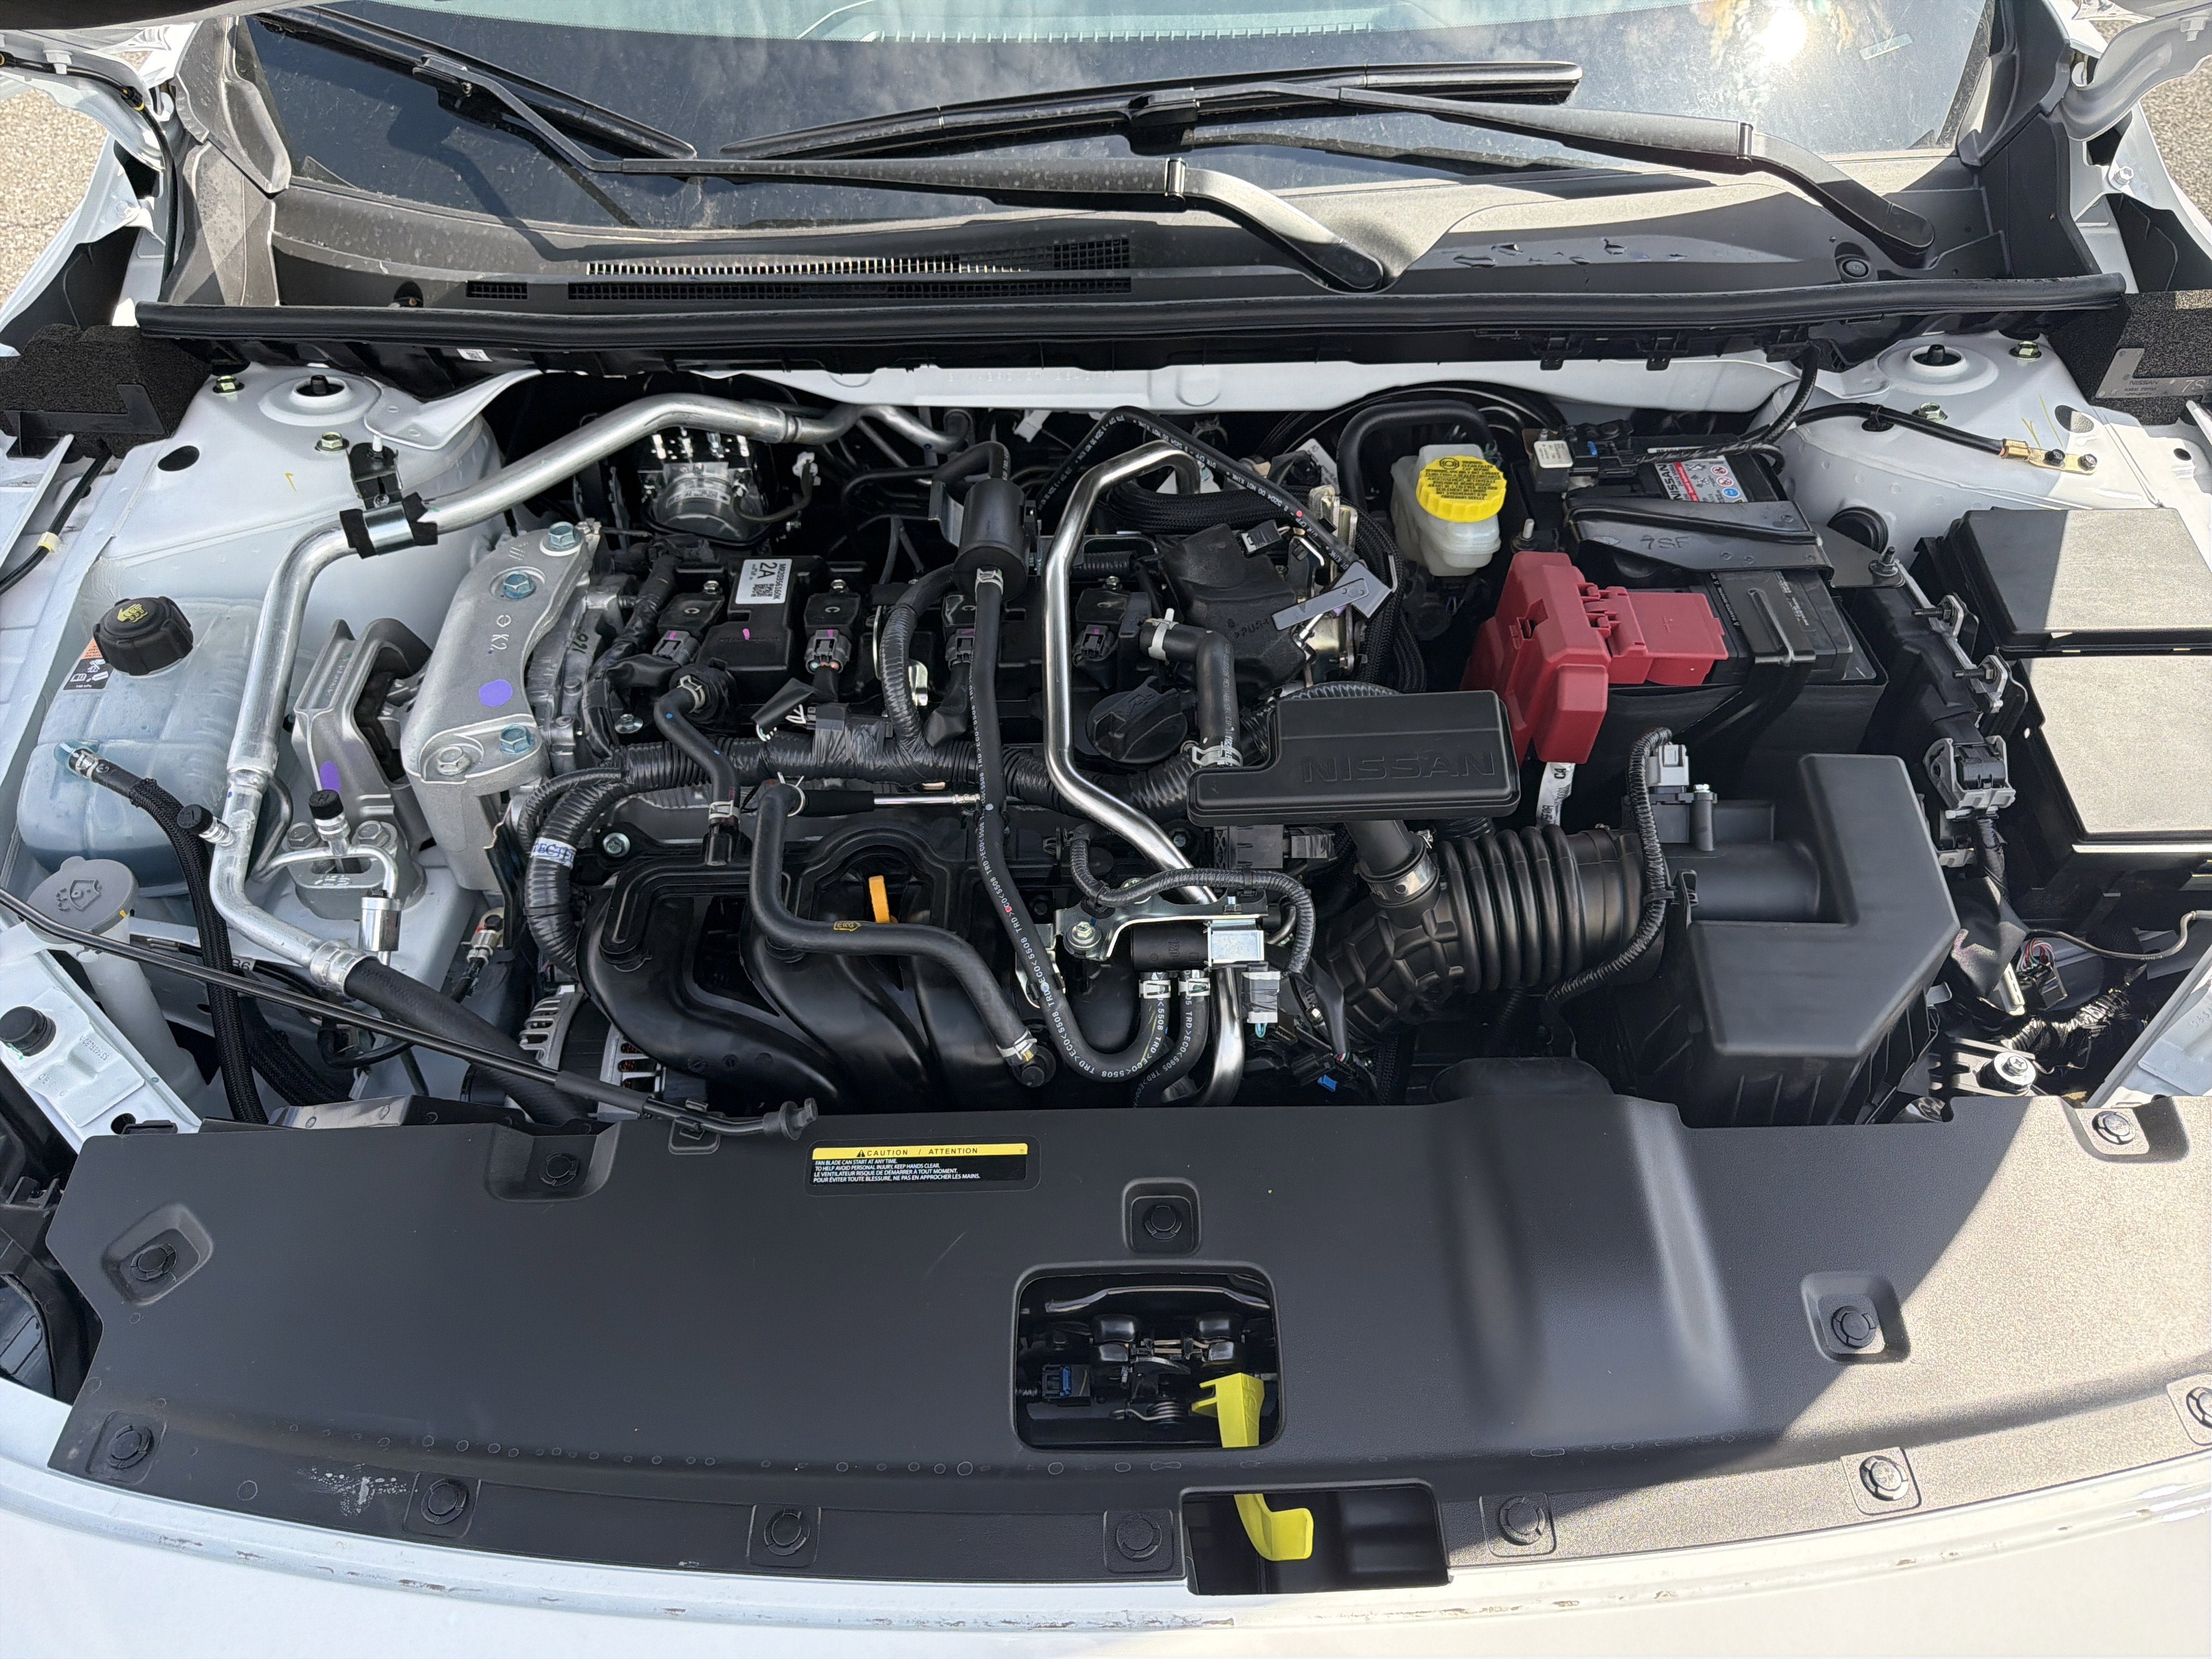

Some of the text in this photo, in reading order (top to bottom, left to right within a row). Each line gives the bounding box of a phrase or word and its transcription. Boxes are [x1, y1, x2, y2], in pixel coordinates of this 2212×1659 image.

[1232, 472, 1245, 486] KINK
[1246, 481, 1257, 492] NOT
[1657, 464, 1683, 500] NISSAN
[757, 562, 778, 579] 2A
[1302, 752, 1495, 783] NISSAN
[1554, 768, 1566, 780] CA
